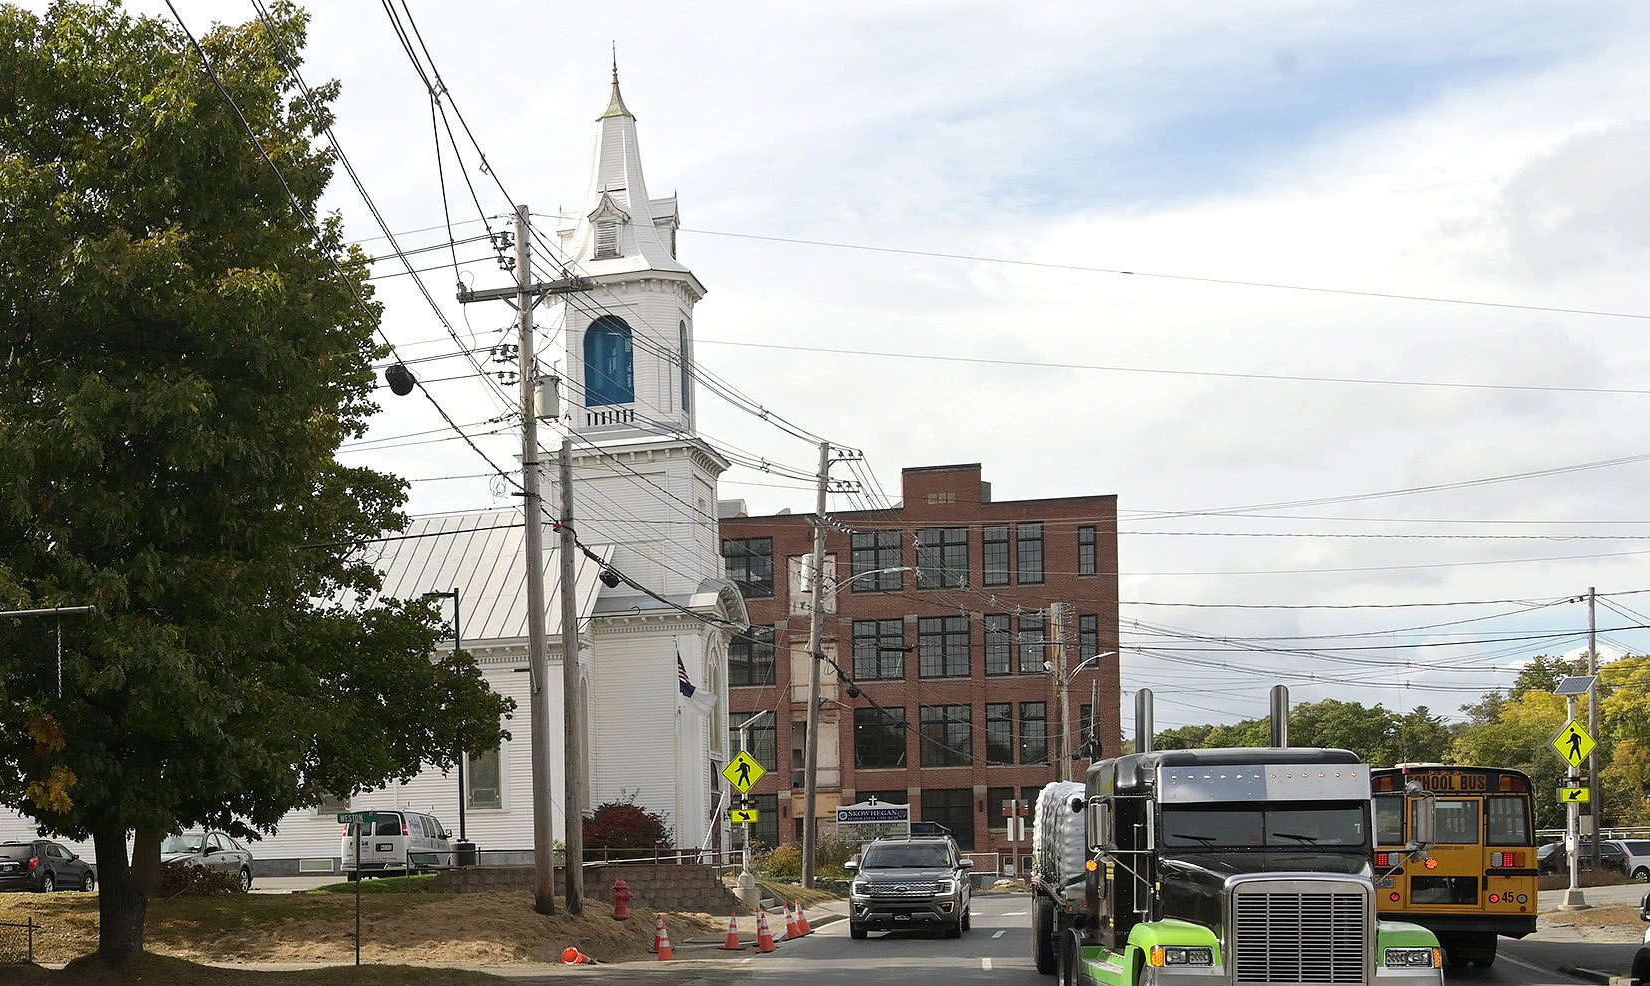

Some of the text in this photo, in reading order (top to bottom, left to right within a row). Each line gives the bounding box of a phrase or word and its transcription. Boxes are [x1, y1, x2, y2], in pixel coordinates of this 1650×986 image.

[1461, 774, 1486, 790] BUS
[848, 809, 898, 817] SKOWHEGAN
[1501, 891, 1514, 903] 45
